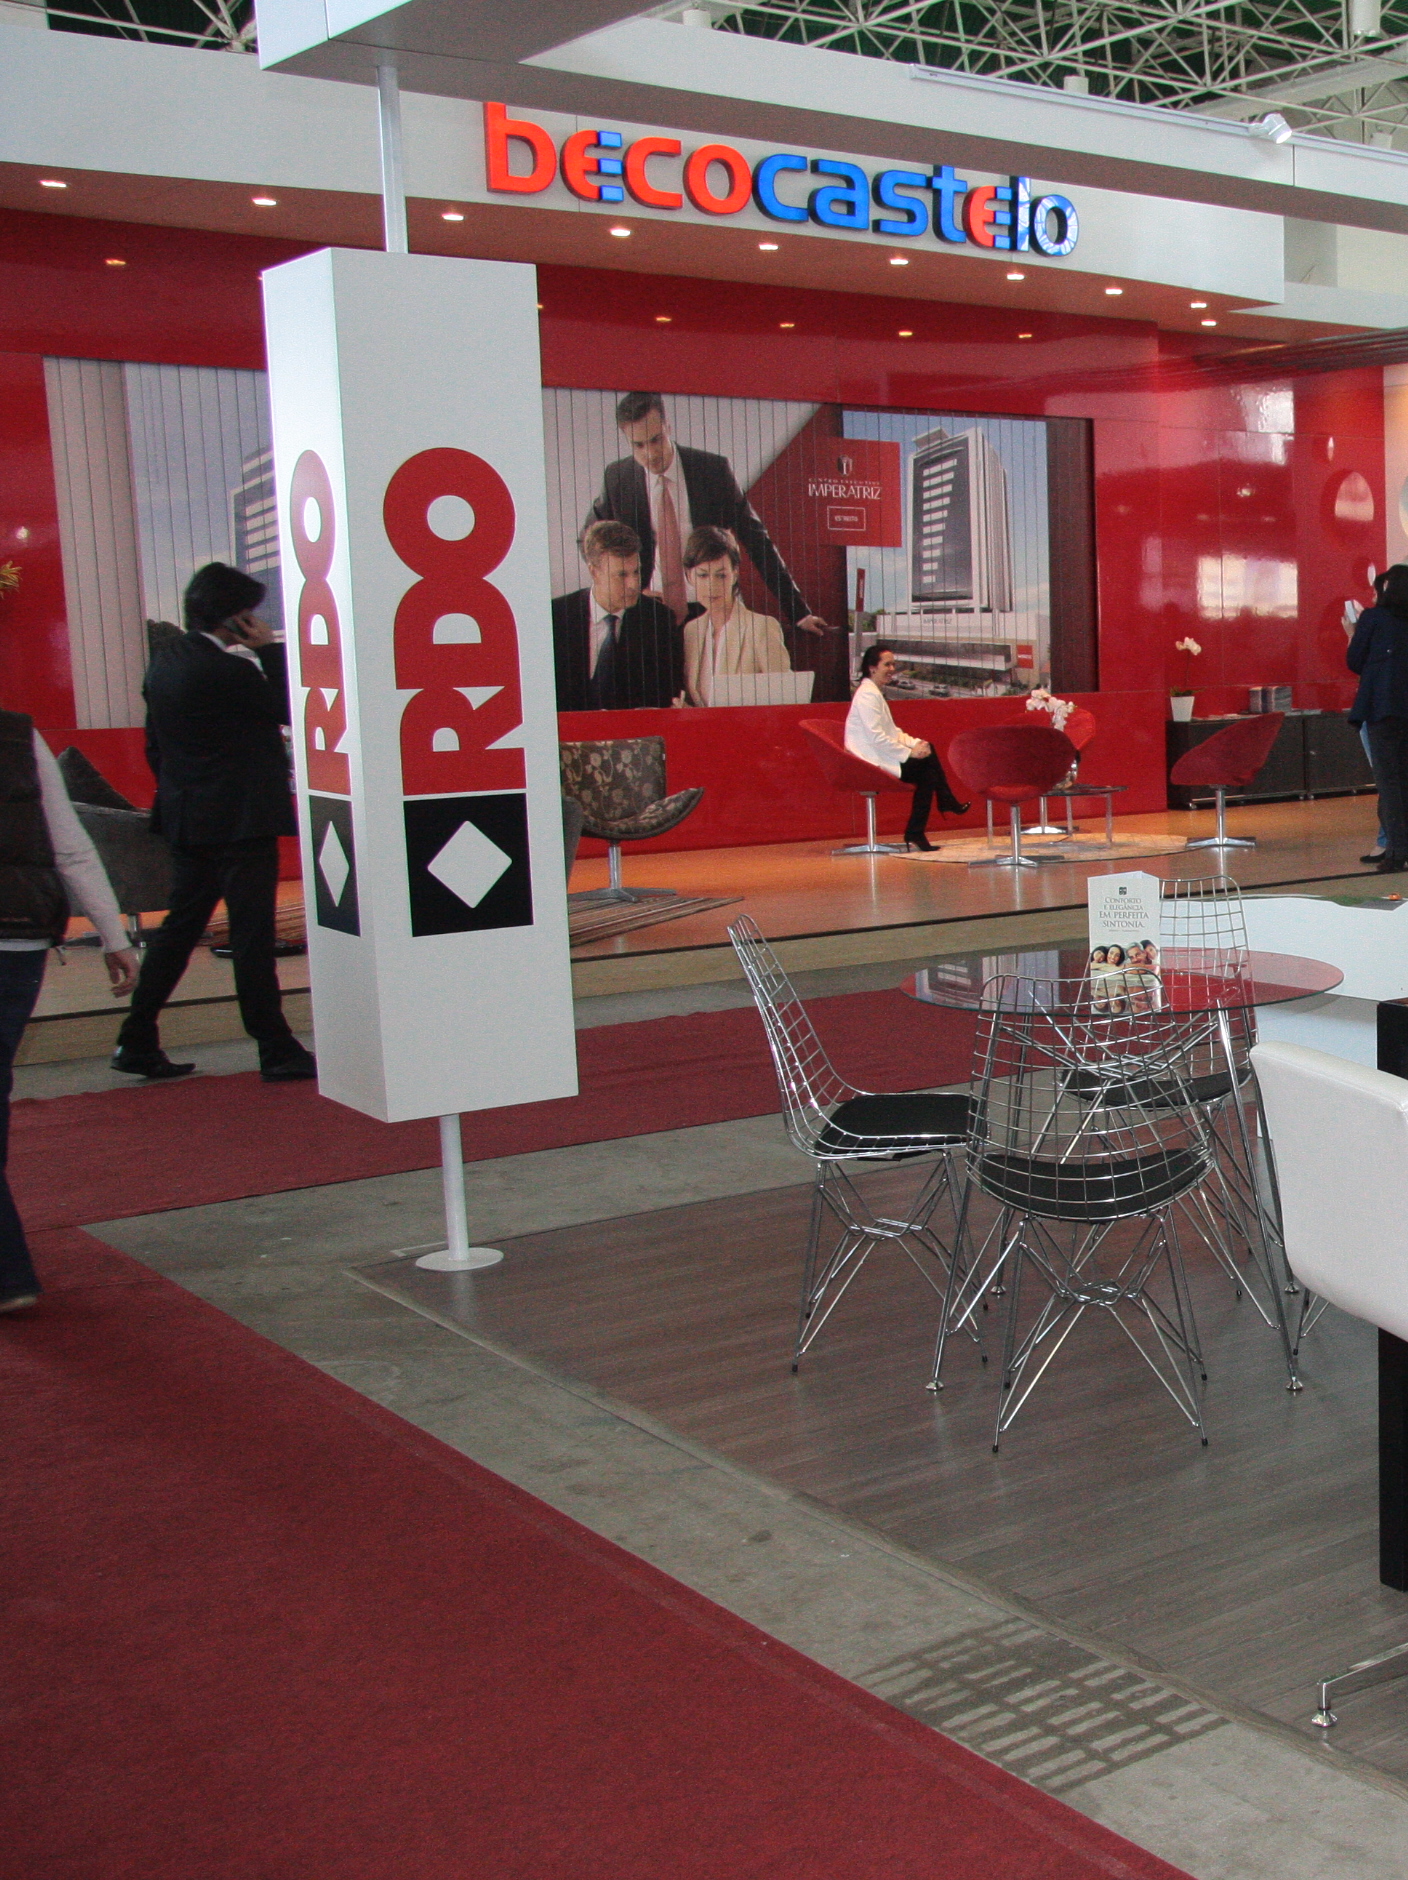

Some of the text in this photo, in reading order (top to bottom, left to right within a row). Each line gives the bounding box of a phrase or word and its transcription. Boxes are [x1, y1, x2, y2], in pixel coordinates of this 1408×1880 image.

[808, 483, 882, 500] IMPERATRIZ
[290, 449, 352, 796] RDO
[383, 446, 528, 797] RDO
[1099, 910, 1149, 919] EM PERFEITA
